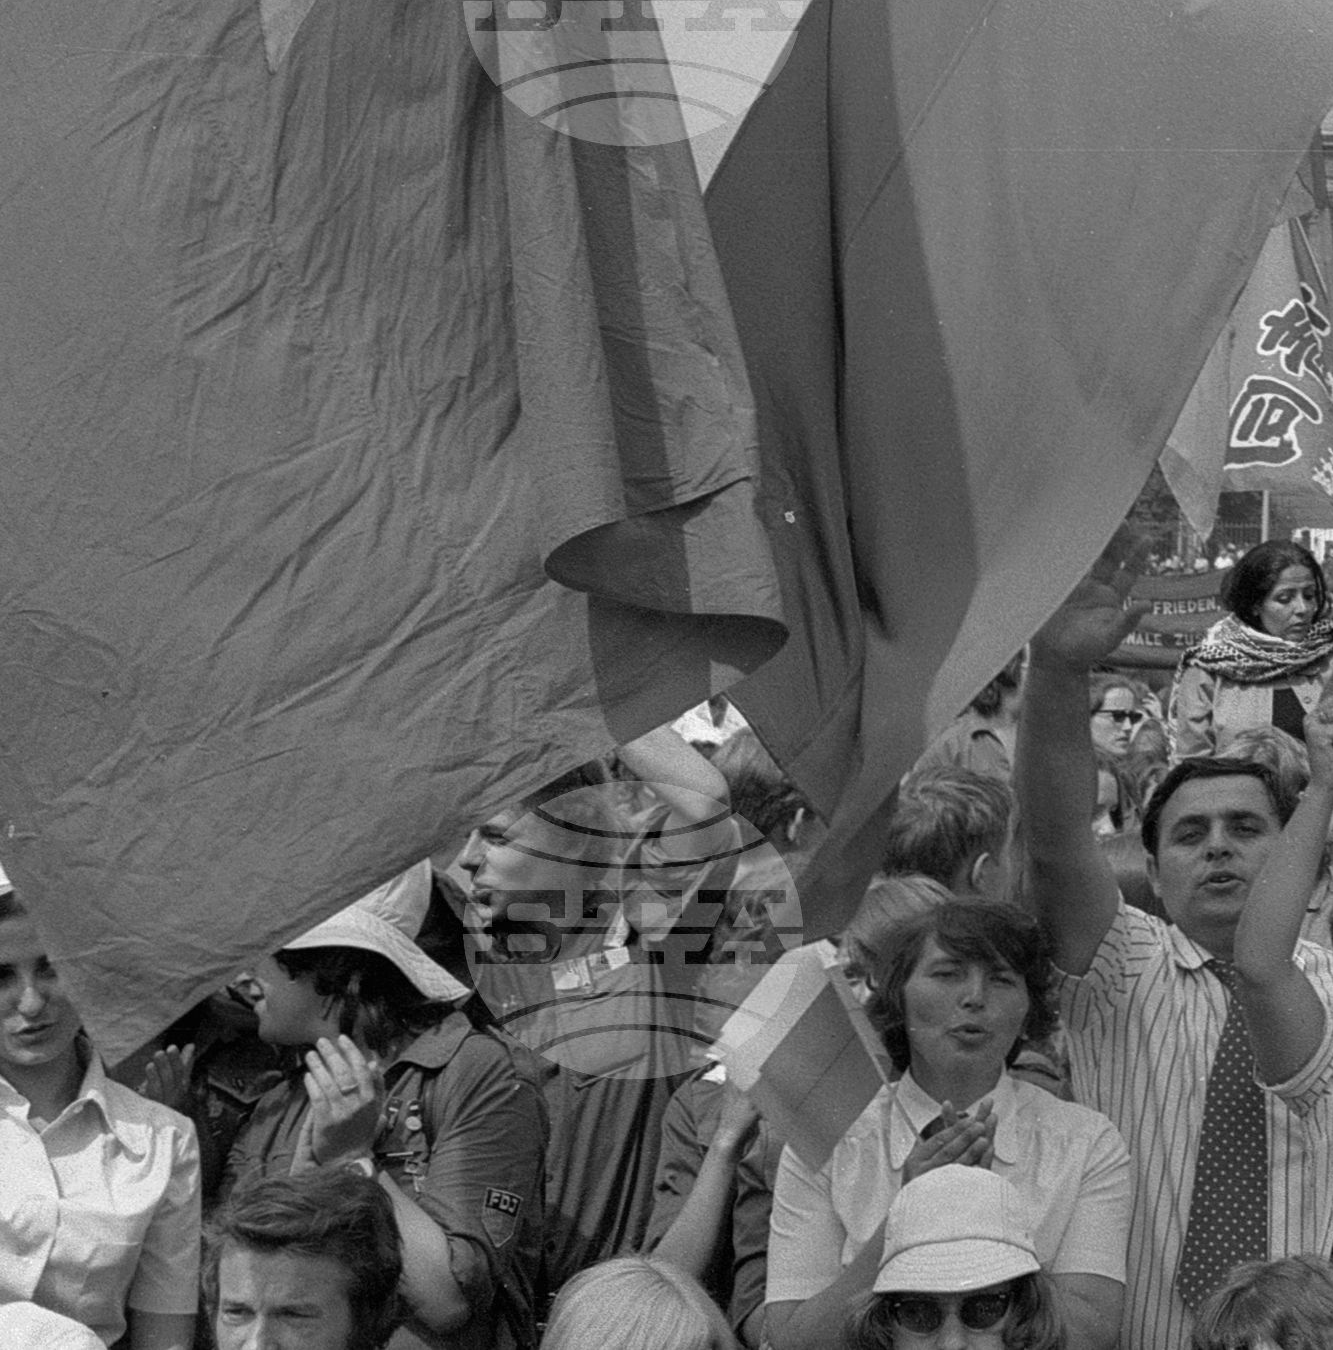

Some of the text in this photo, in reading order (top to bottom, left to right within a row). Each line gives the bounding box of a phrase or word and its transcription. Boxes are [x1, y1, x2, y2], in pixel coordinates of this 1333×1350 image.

[1153, 596, 1221, 615] FRIEDEN,
[1122, 631, 1163, 646] NALE
[489, 1191, 519, 1213] FDJ
